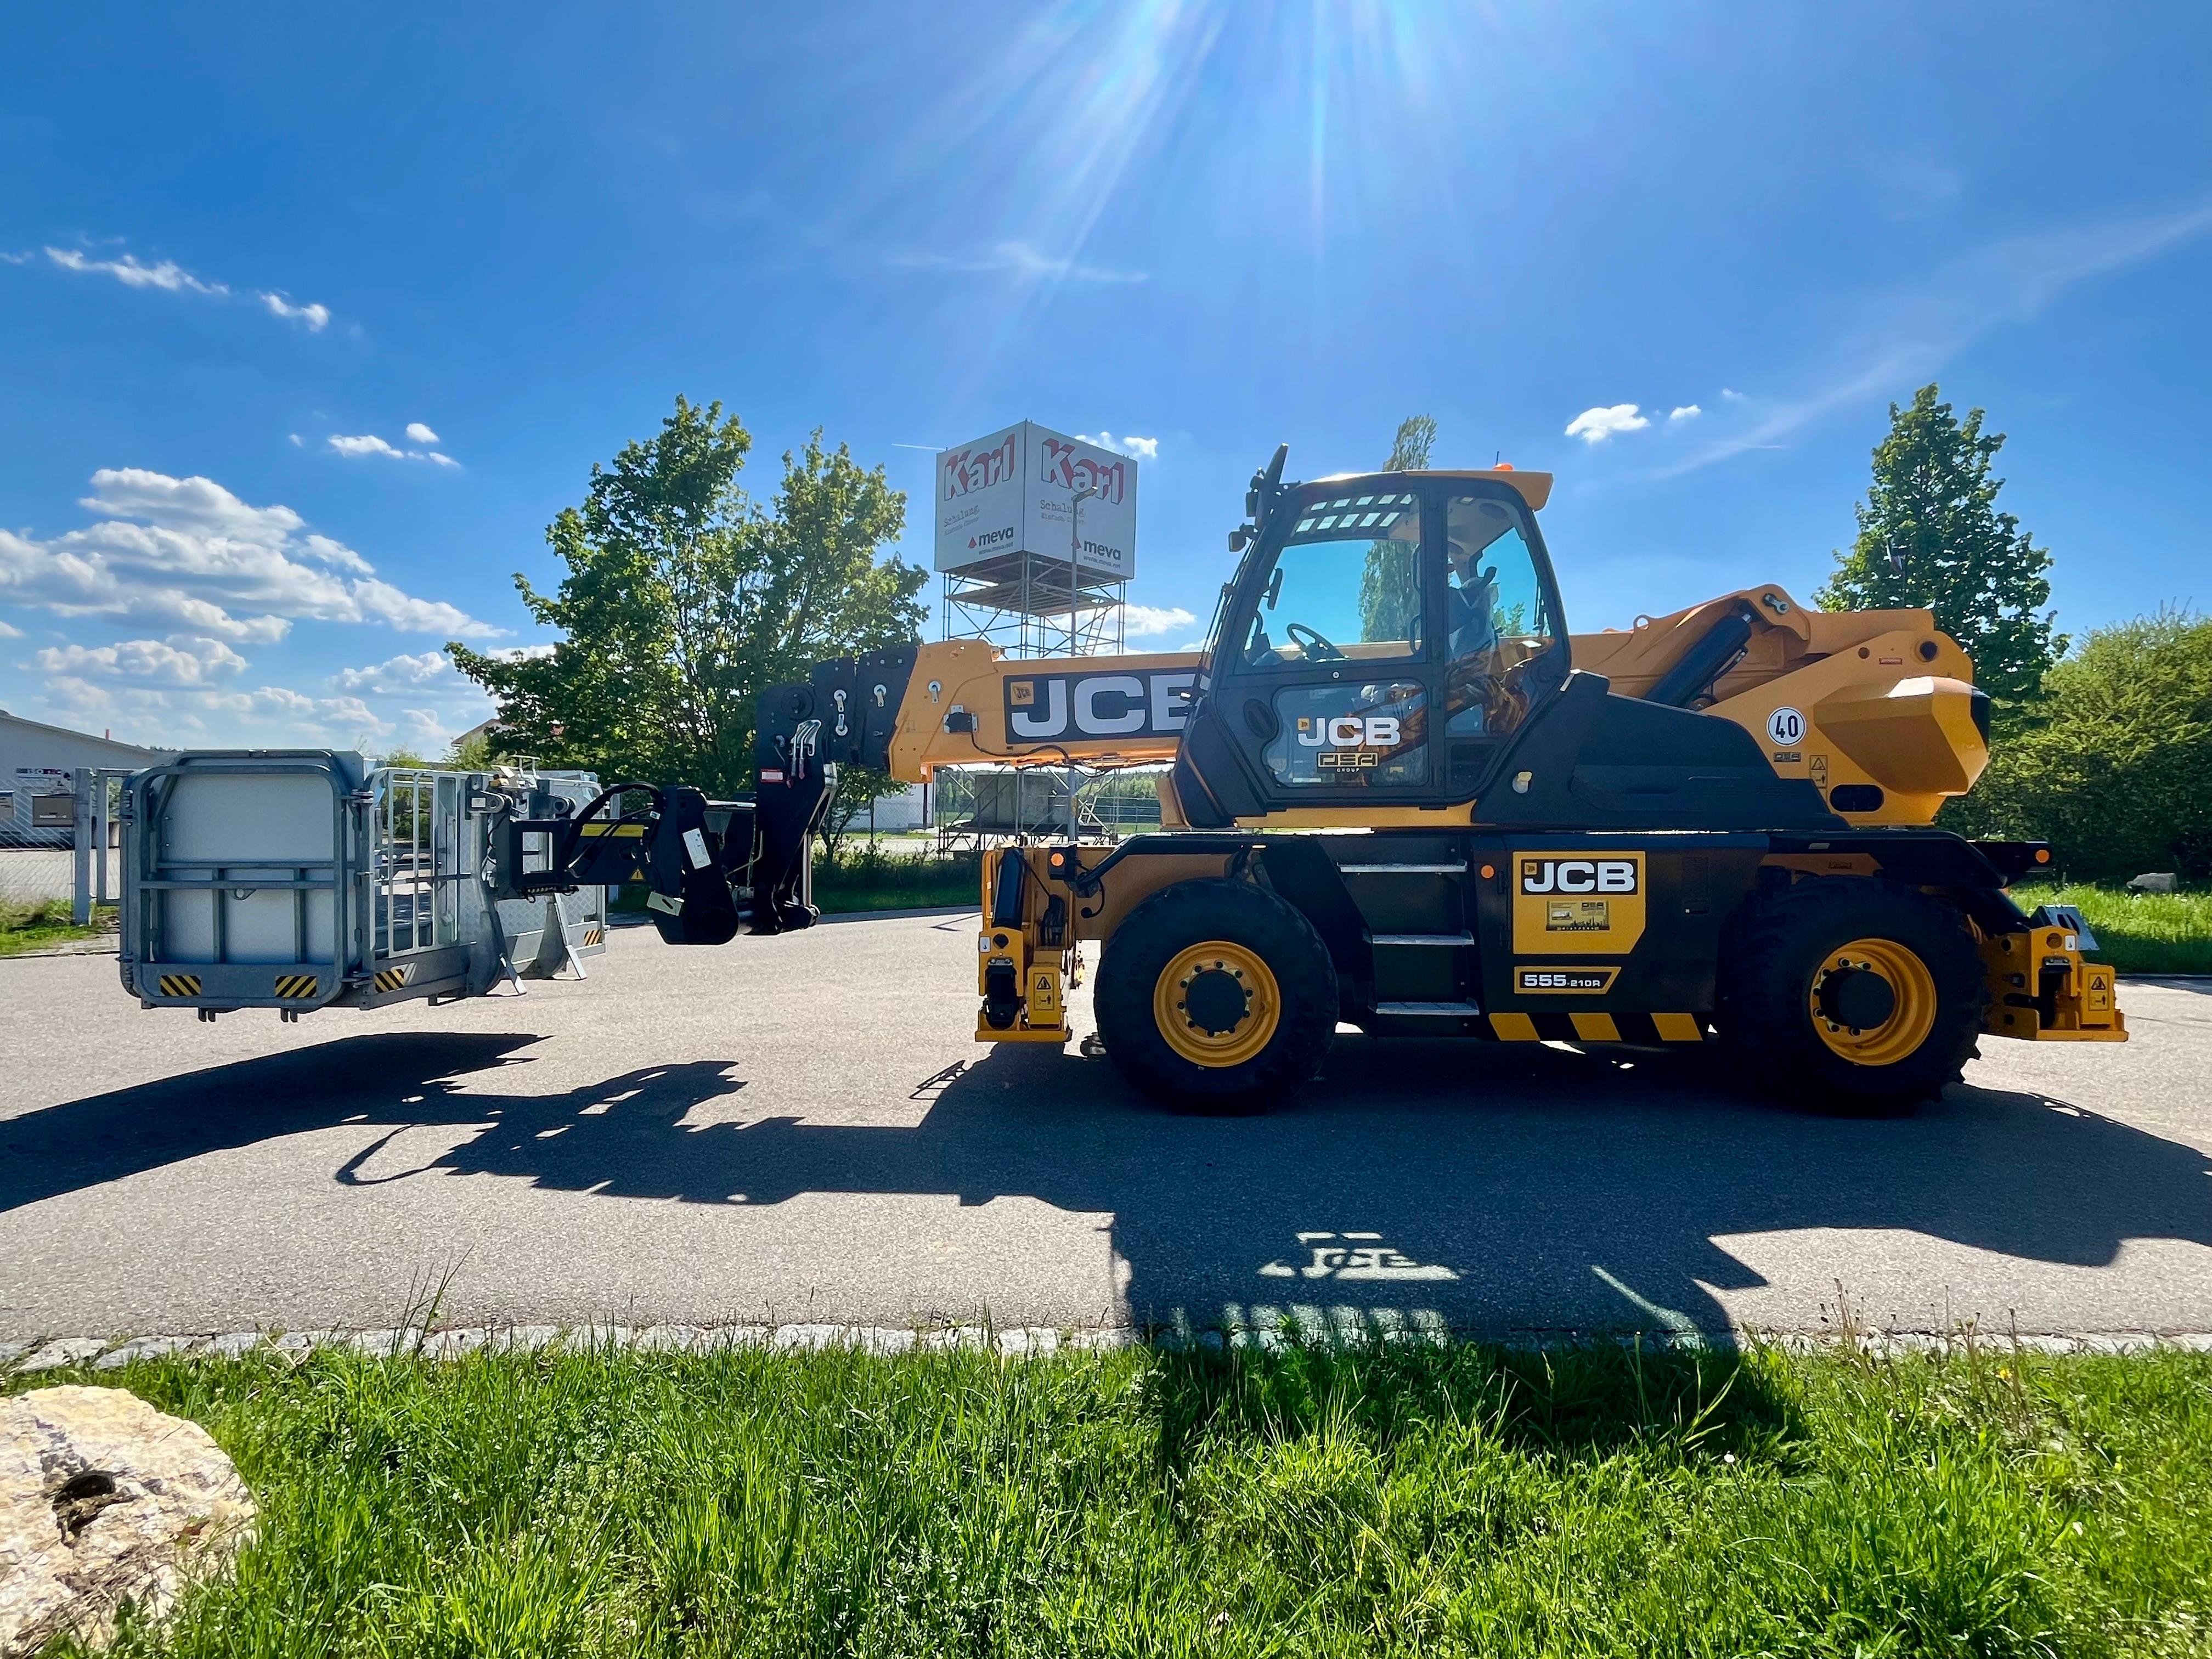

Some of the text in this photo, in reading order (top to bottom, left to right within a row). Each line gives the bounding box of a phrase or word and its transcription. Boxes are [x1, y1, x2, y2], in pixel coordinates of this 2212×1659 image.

[944, 434, 1015, 501] Karl
[1041, 438, 1124, 505] Karl
[979, 527, 1014, 547] meva
[1084, 540, 1121, 561] meva
[1298, 718, 1401, 746] JCB
[1775, 715, 1798, 738] 40
[1524, 862, 1635, 892] JCB
